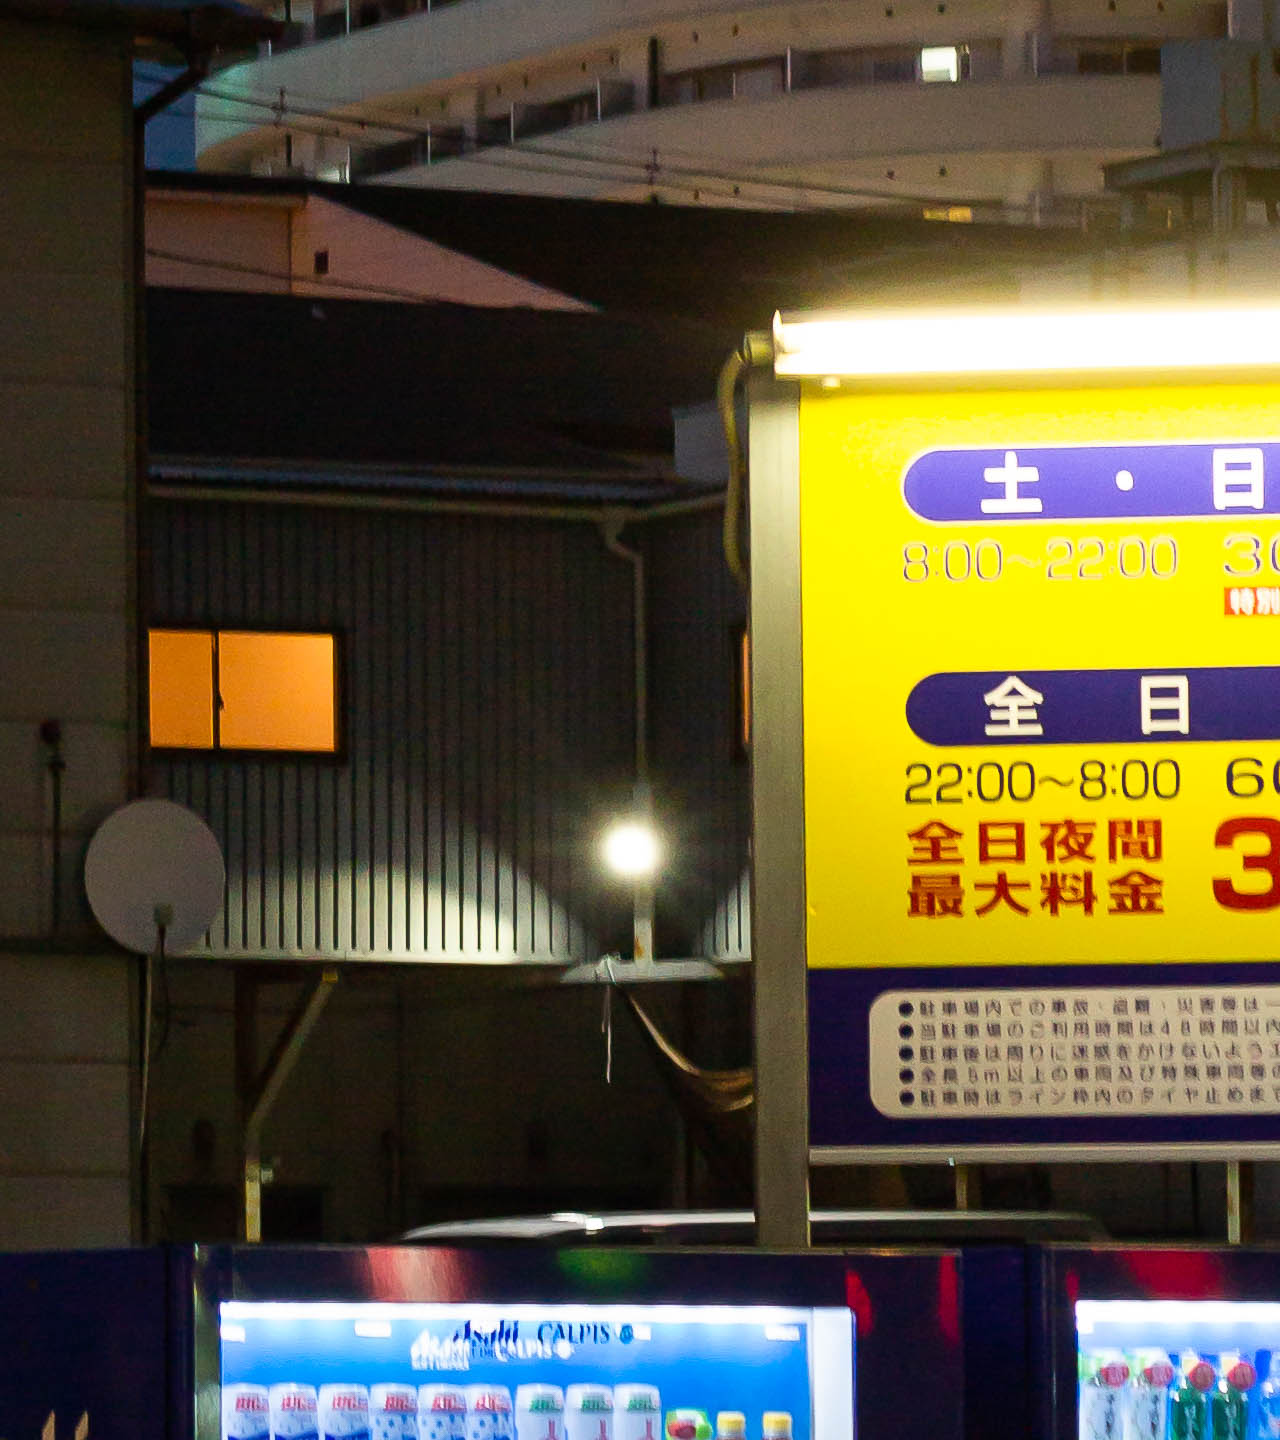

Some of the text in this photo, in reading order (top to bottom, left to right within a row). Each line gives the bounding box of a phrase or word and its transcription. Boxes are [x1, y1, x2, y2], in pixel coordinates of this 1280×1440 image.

[906, 818, 1166, 868] 全日夜間
[906, 872, 1166, 919] 最大料金
